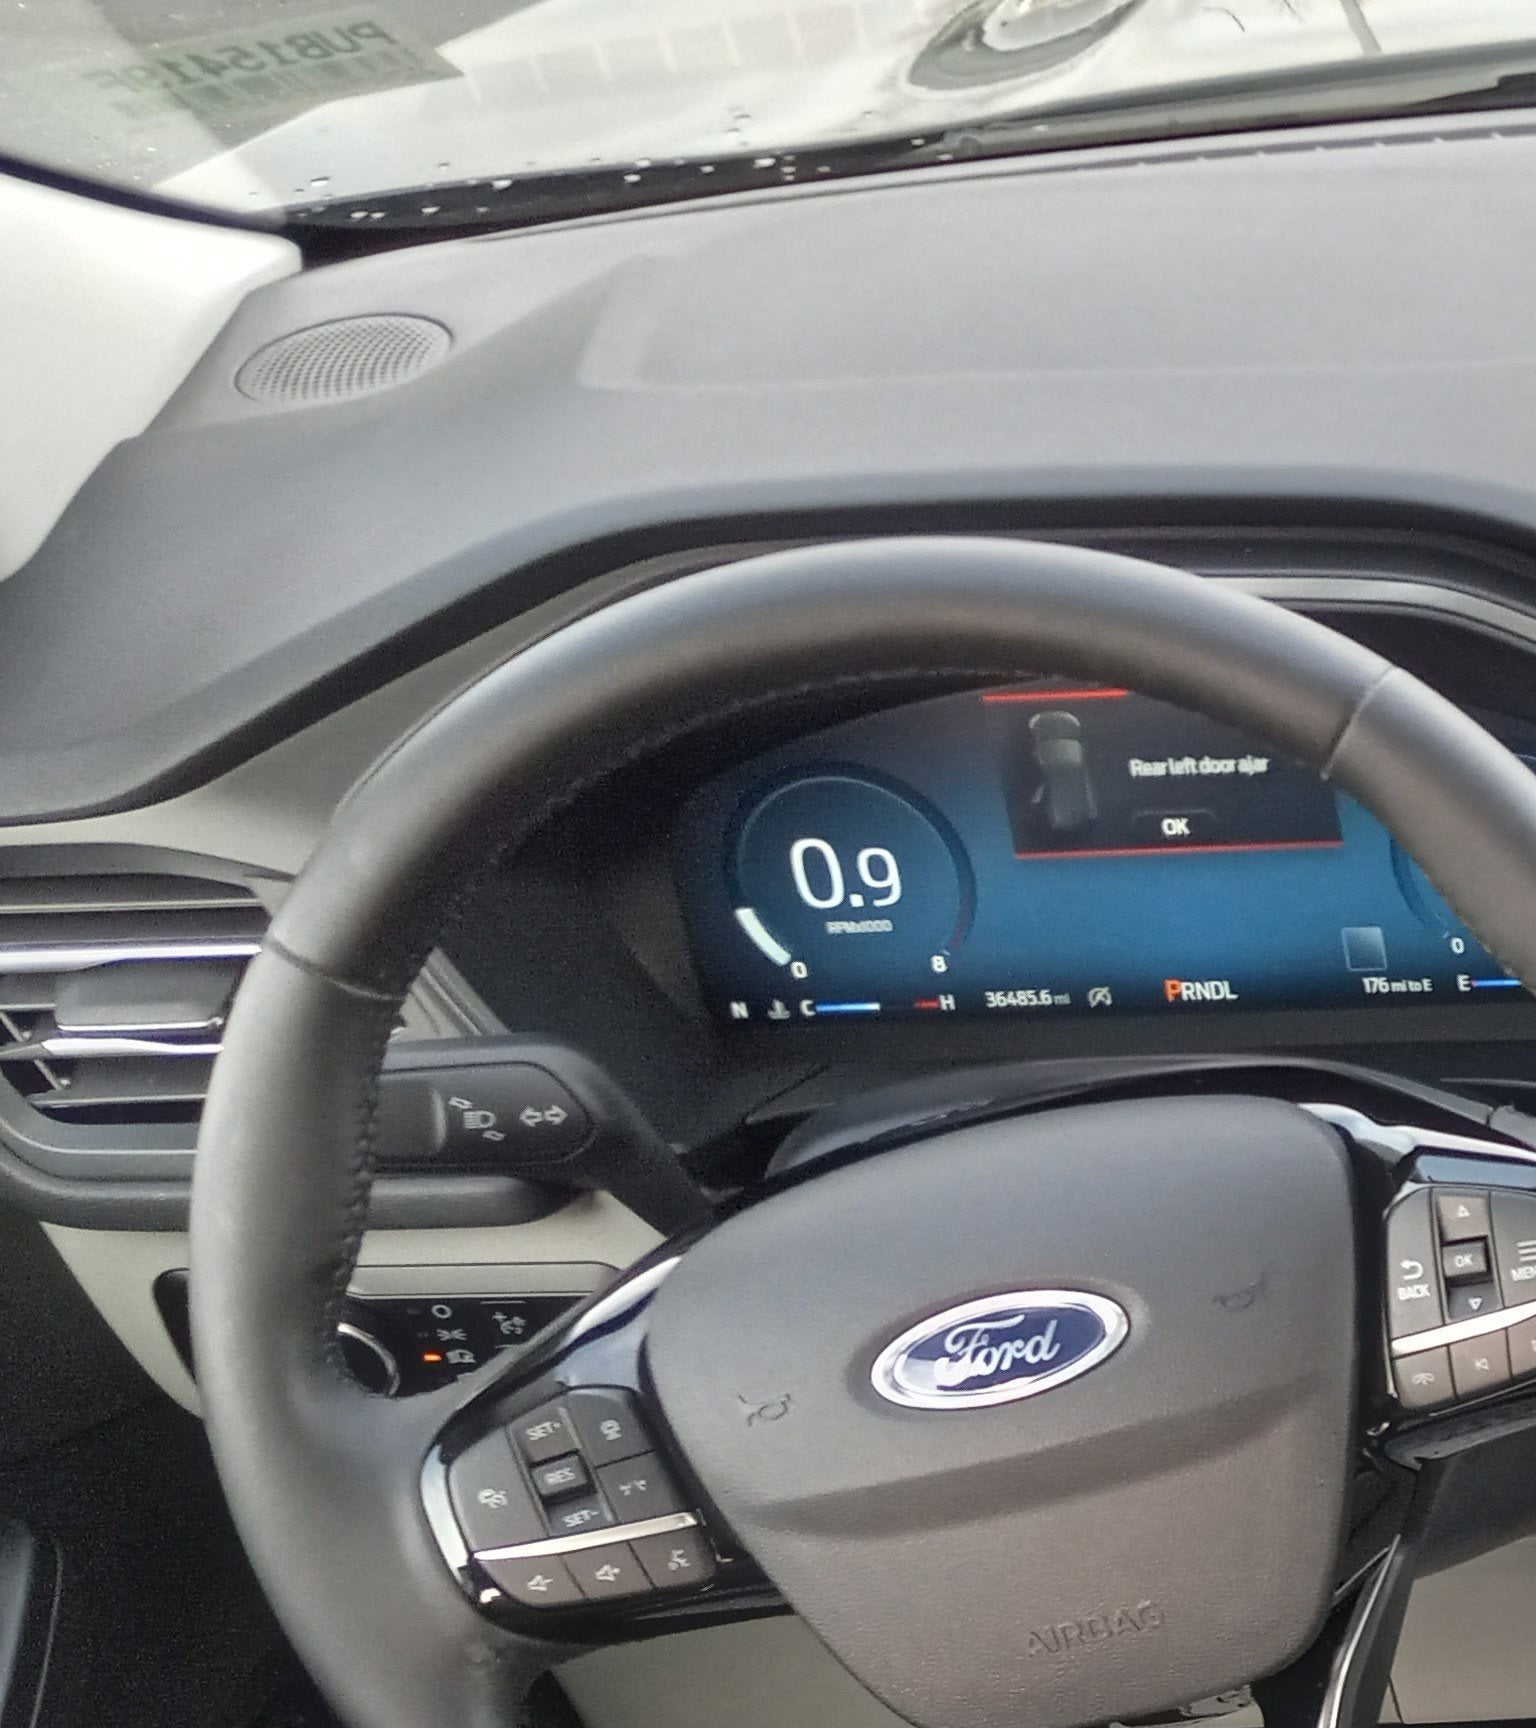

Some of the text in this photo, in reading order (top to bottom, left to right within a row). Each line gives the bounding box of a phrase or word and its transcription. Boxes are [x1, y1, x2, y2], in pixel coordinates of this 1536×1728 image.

[1129, 754, 1270, 777] Rear left door ajar
[1160, 817, 1191, 836] OK
[789, 838, 902, 909] 0.9
[1451, 937, 1465, 954] 0
[790, 961, 808, 979] 0
[930, 955, 948, 973] 8
[1363, 976, 1390, 993] 176
[1457, 974, 1471, 991] E
[800, 999, 816, 1017] C
[939, 994, 956, 1011] H
[1454, 1254, 1473, 1268] OK
[1396, 1284, 1431, 1300] BACK
[934, 1314, 1061, 1388] Ford
[1027, 1601, 1168, 1656] AIRBAG
